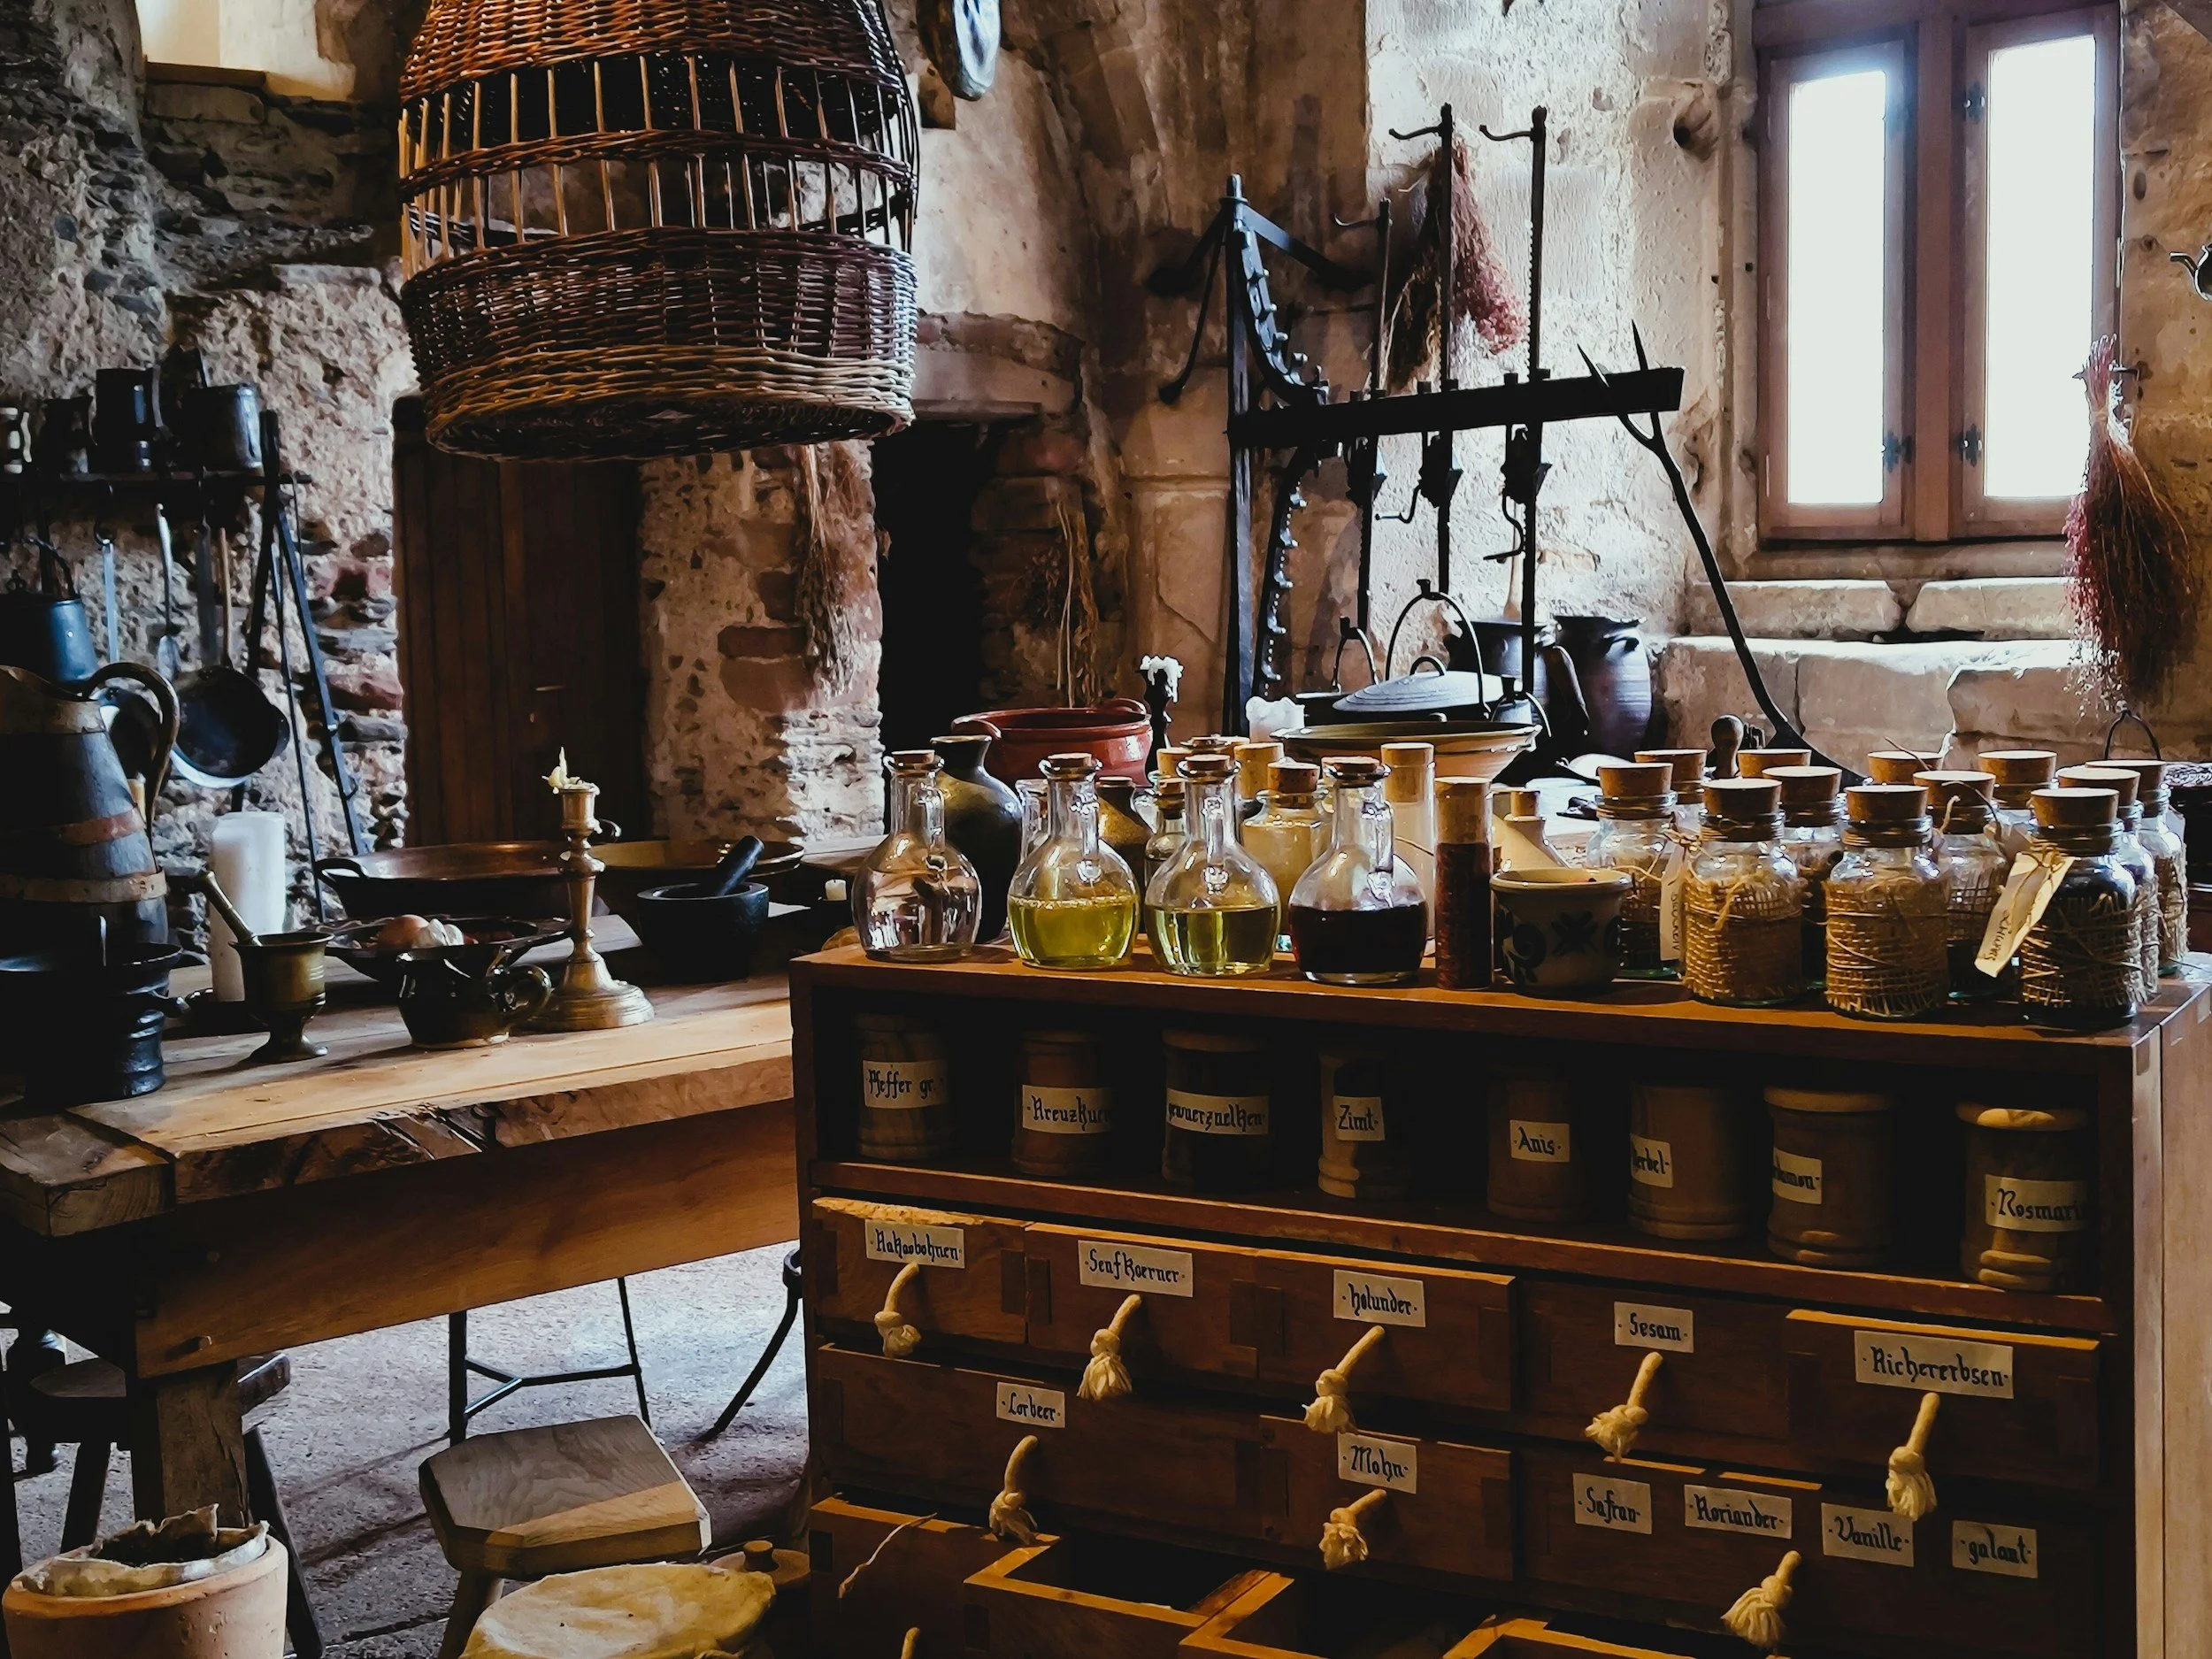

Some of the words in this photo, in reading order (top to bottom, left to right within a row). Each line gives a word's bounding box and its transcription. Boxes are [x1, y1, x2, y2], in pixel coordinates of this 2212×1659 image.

[868, 1069, 912, 1099] Pfeffer
[1338, 1104, 1375, 1131] Zimt
[1518, 1126, 1555, 1156] Anis
[1997, 1188, 2085, 1221] Rosmari
[1629, 1312, 1681, 1341] Sesam
[1870, 1346, 2004, 1387] Kichererbsen
[1008, 1392, 1056, 1422] Lorbeer
[1350, 1445, 1405, 1483] Mohn
[1586, 1486, 1639, 1525] Safran
[1694, 1494, 1778, 1530] Koriander
[1834, 1516, 1902, 1552] Vanille
